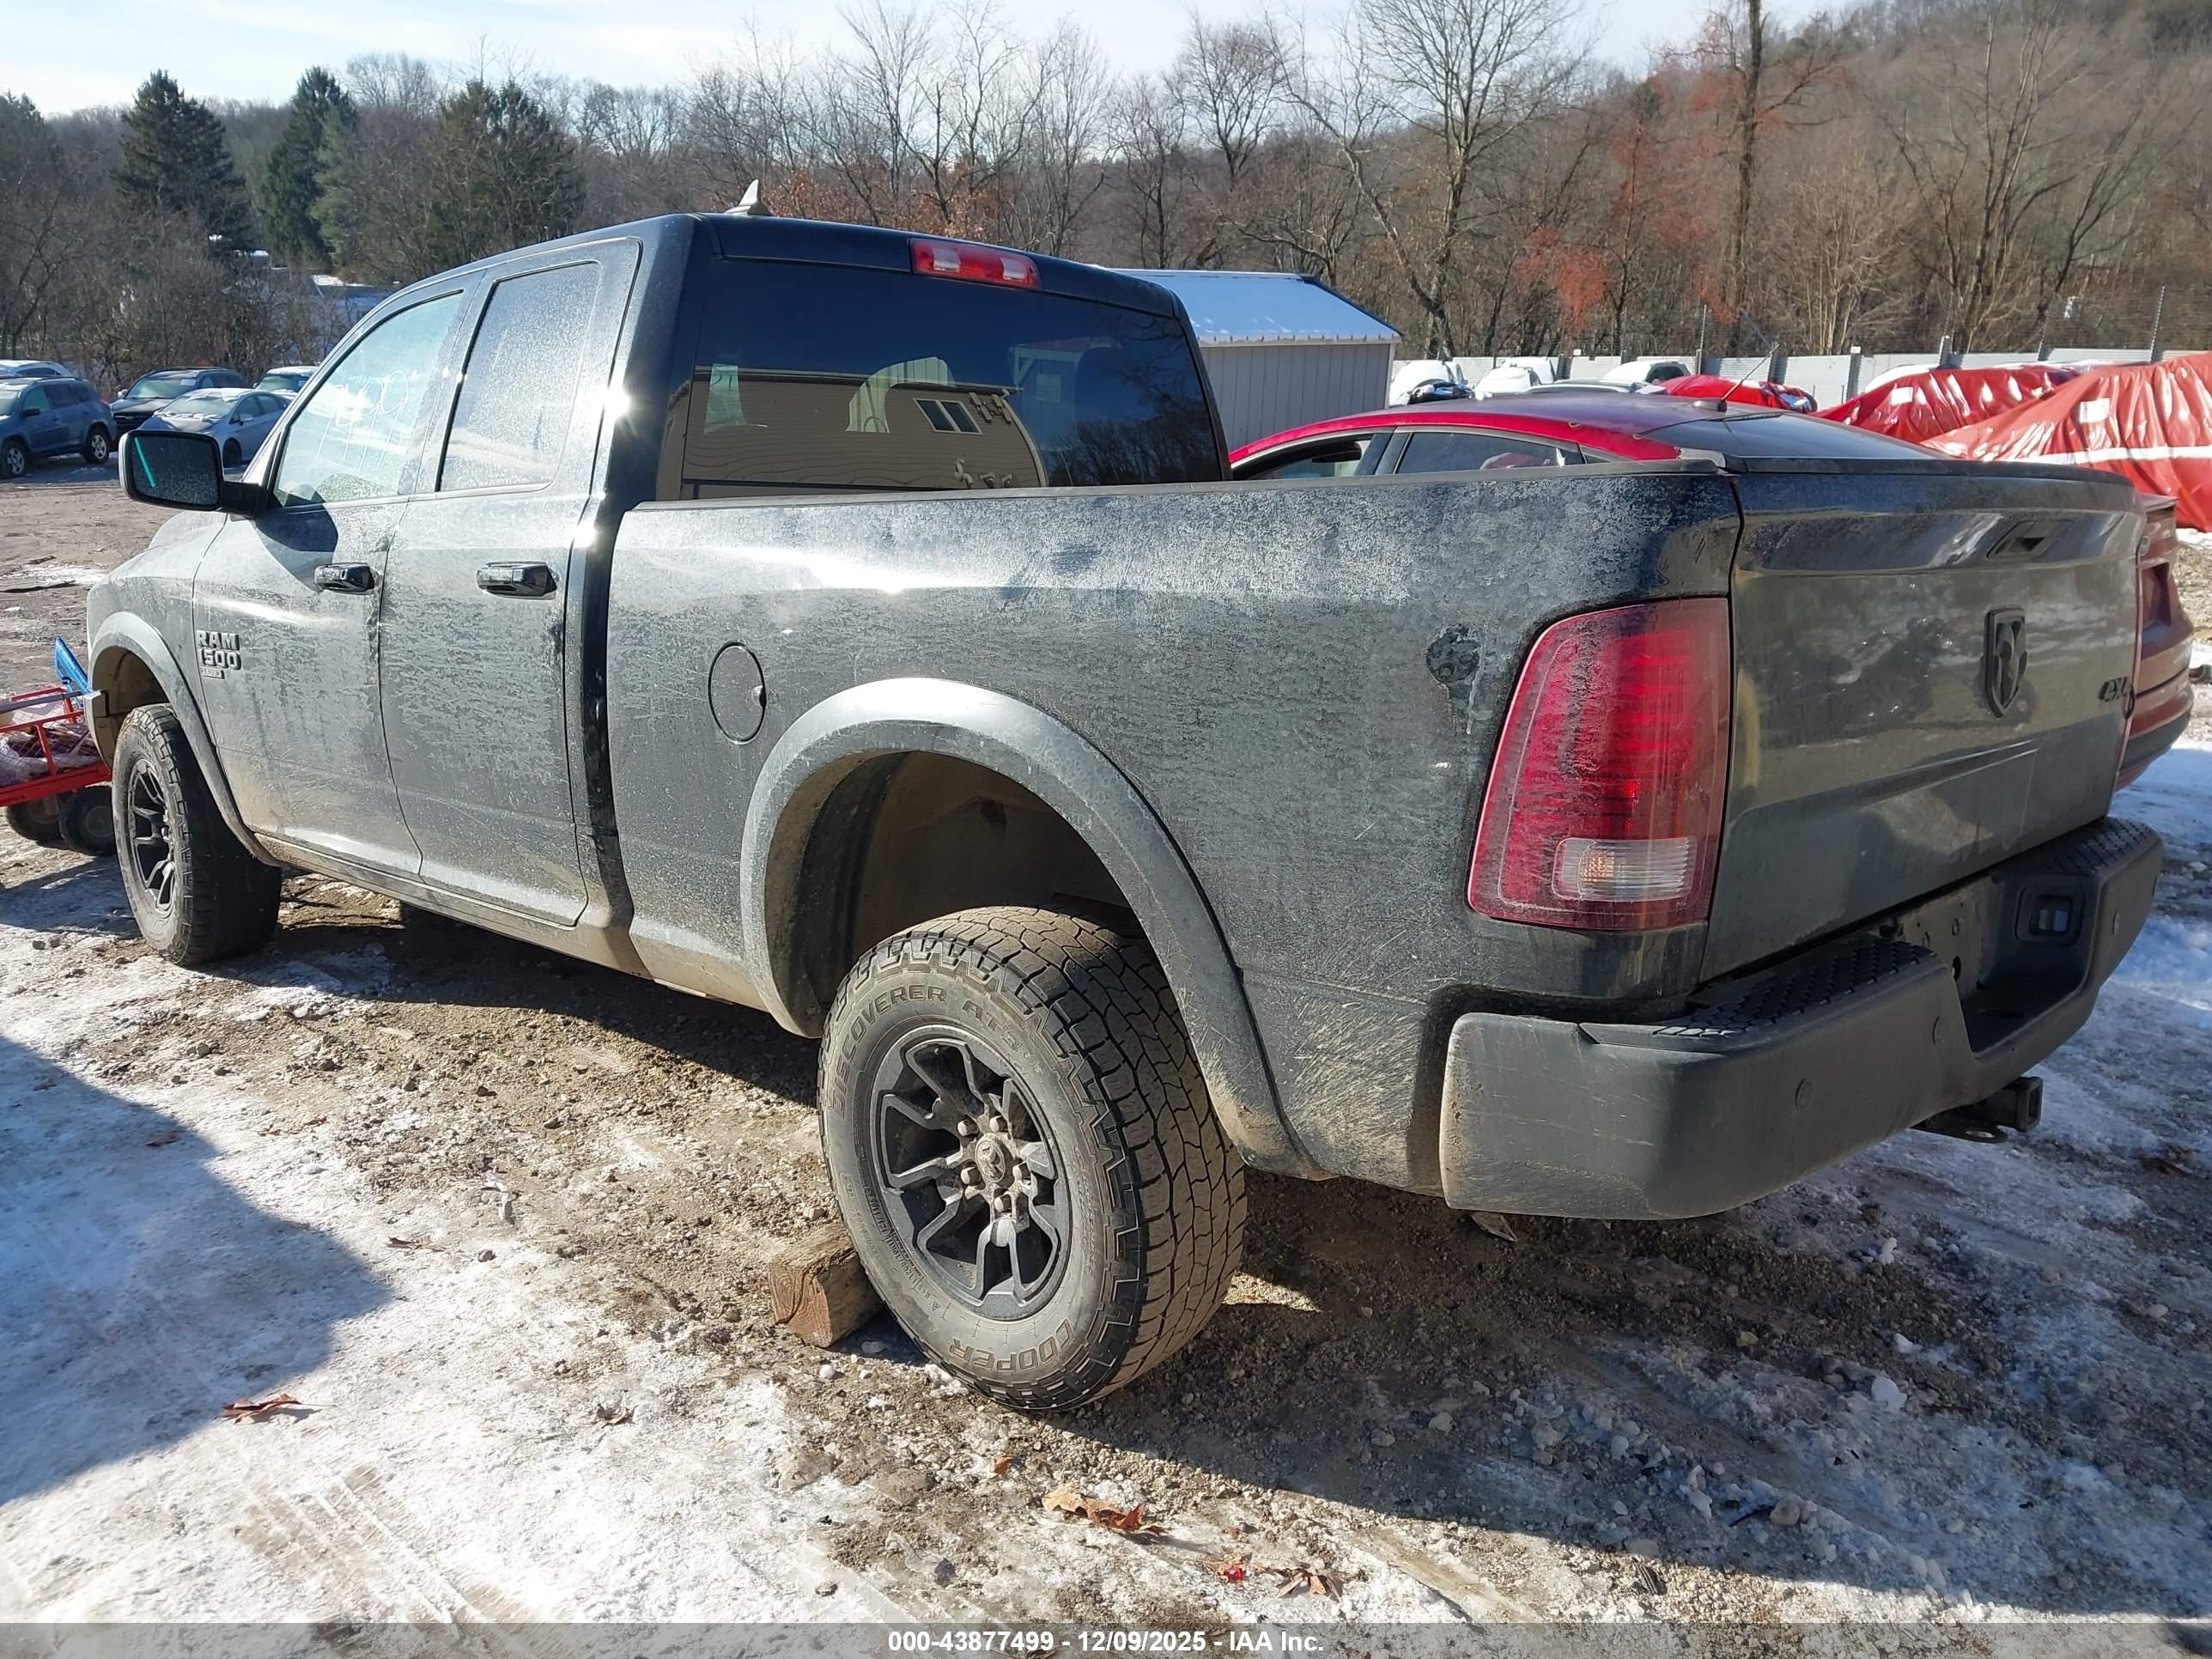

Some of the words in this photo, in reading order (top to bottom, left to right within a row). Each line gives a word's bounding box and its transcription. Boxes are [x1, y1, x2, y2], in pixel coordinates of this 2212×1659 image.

[197, 629, 239, 650] RAM
[198, 648, 241, 670] 1500
[830, 984, 947, 1120] DISCOVERER
[949, 1318, 1074, 1373] COOPER
